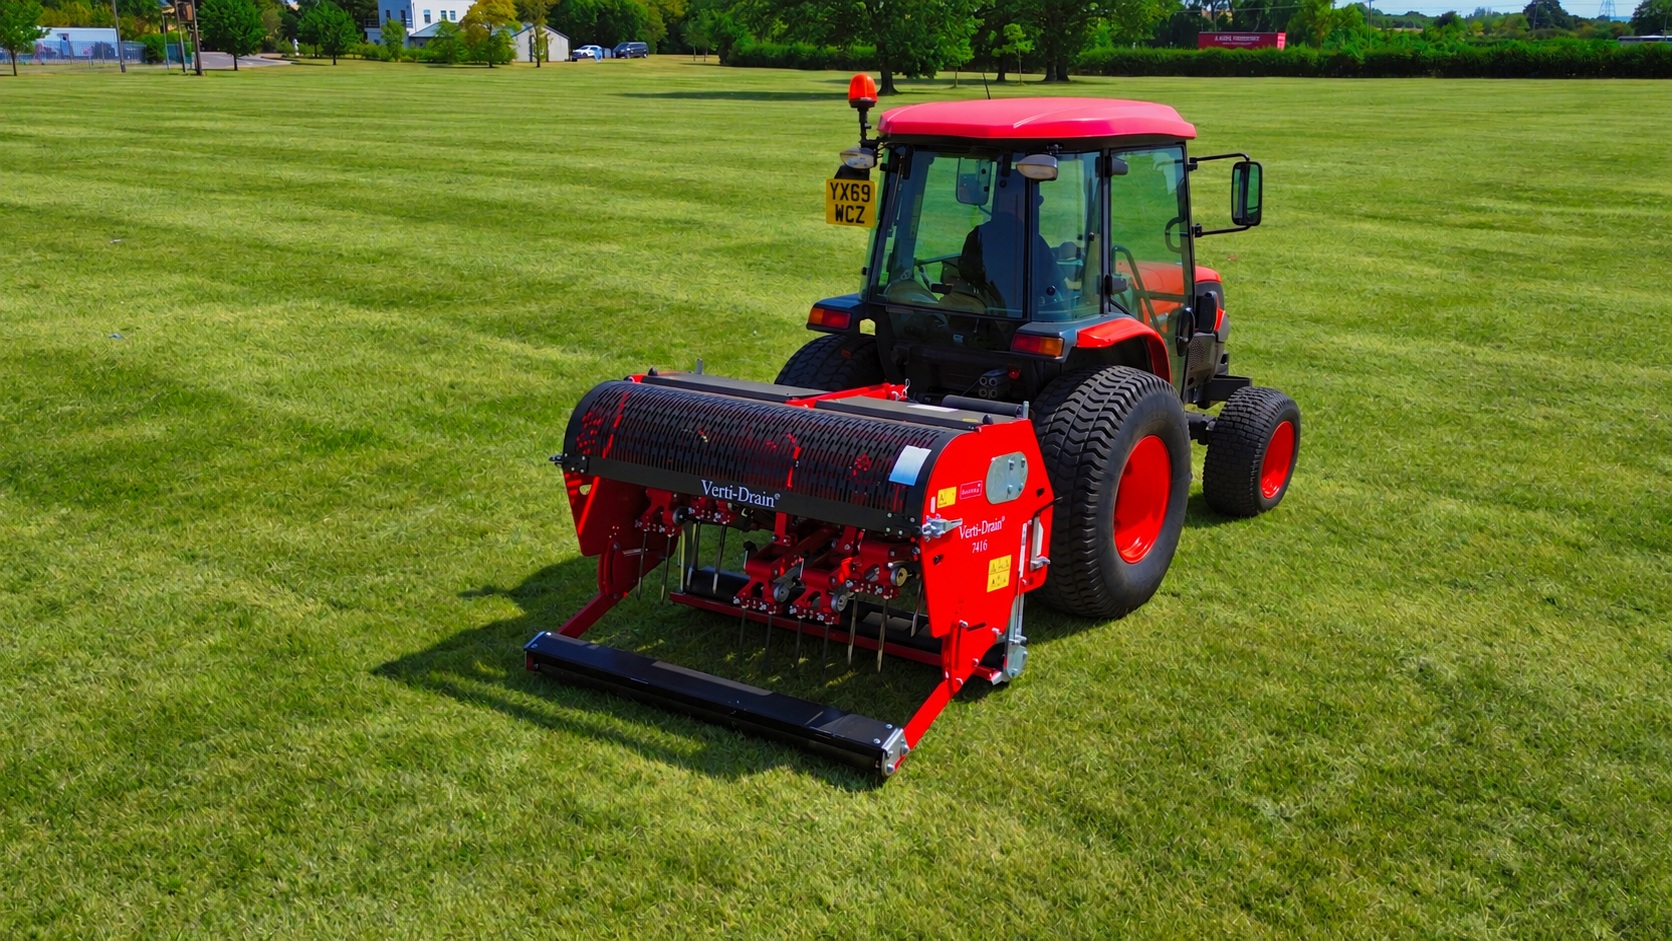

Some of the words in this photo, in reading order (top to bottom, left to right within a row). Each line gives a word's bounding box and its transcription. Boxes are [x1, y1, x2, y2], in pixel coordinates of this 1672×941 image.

[830, 182, 870, 202] YX69
[835, 204, 865, 224] WCZ
[972, 539, 988, 554] 7416
